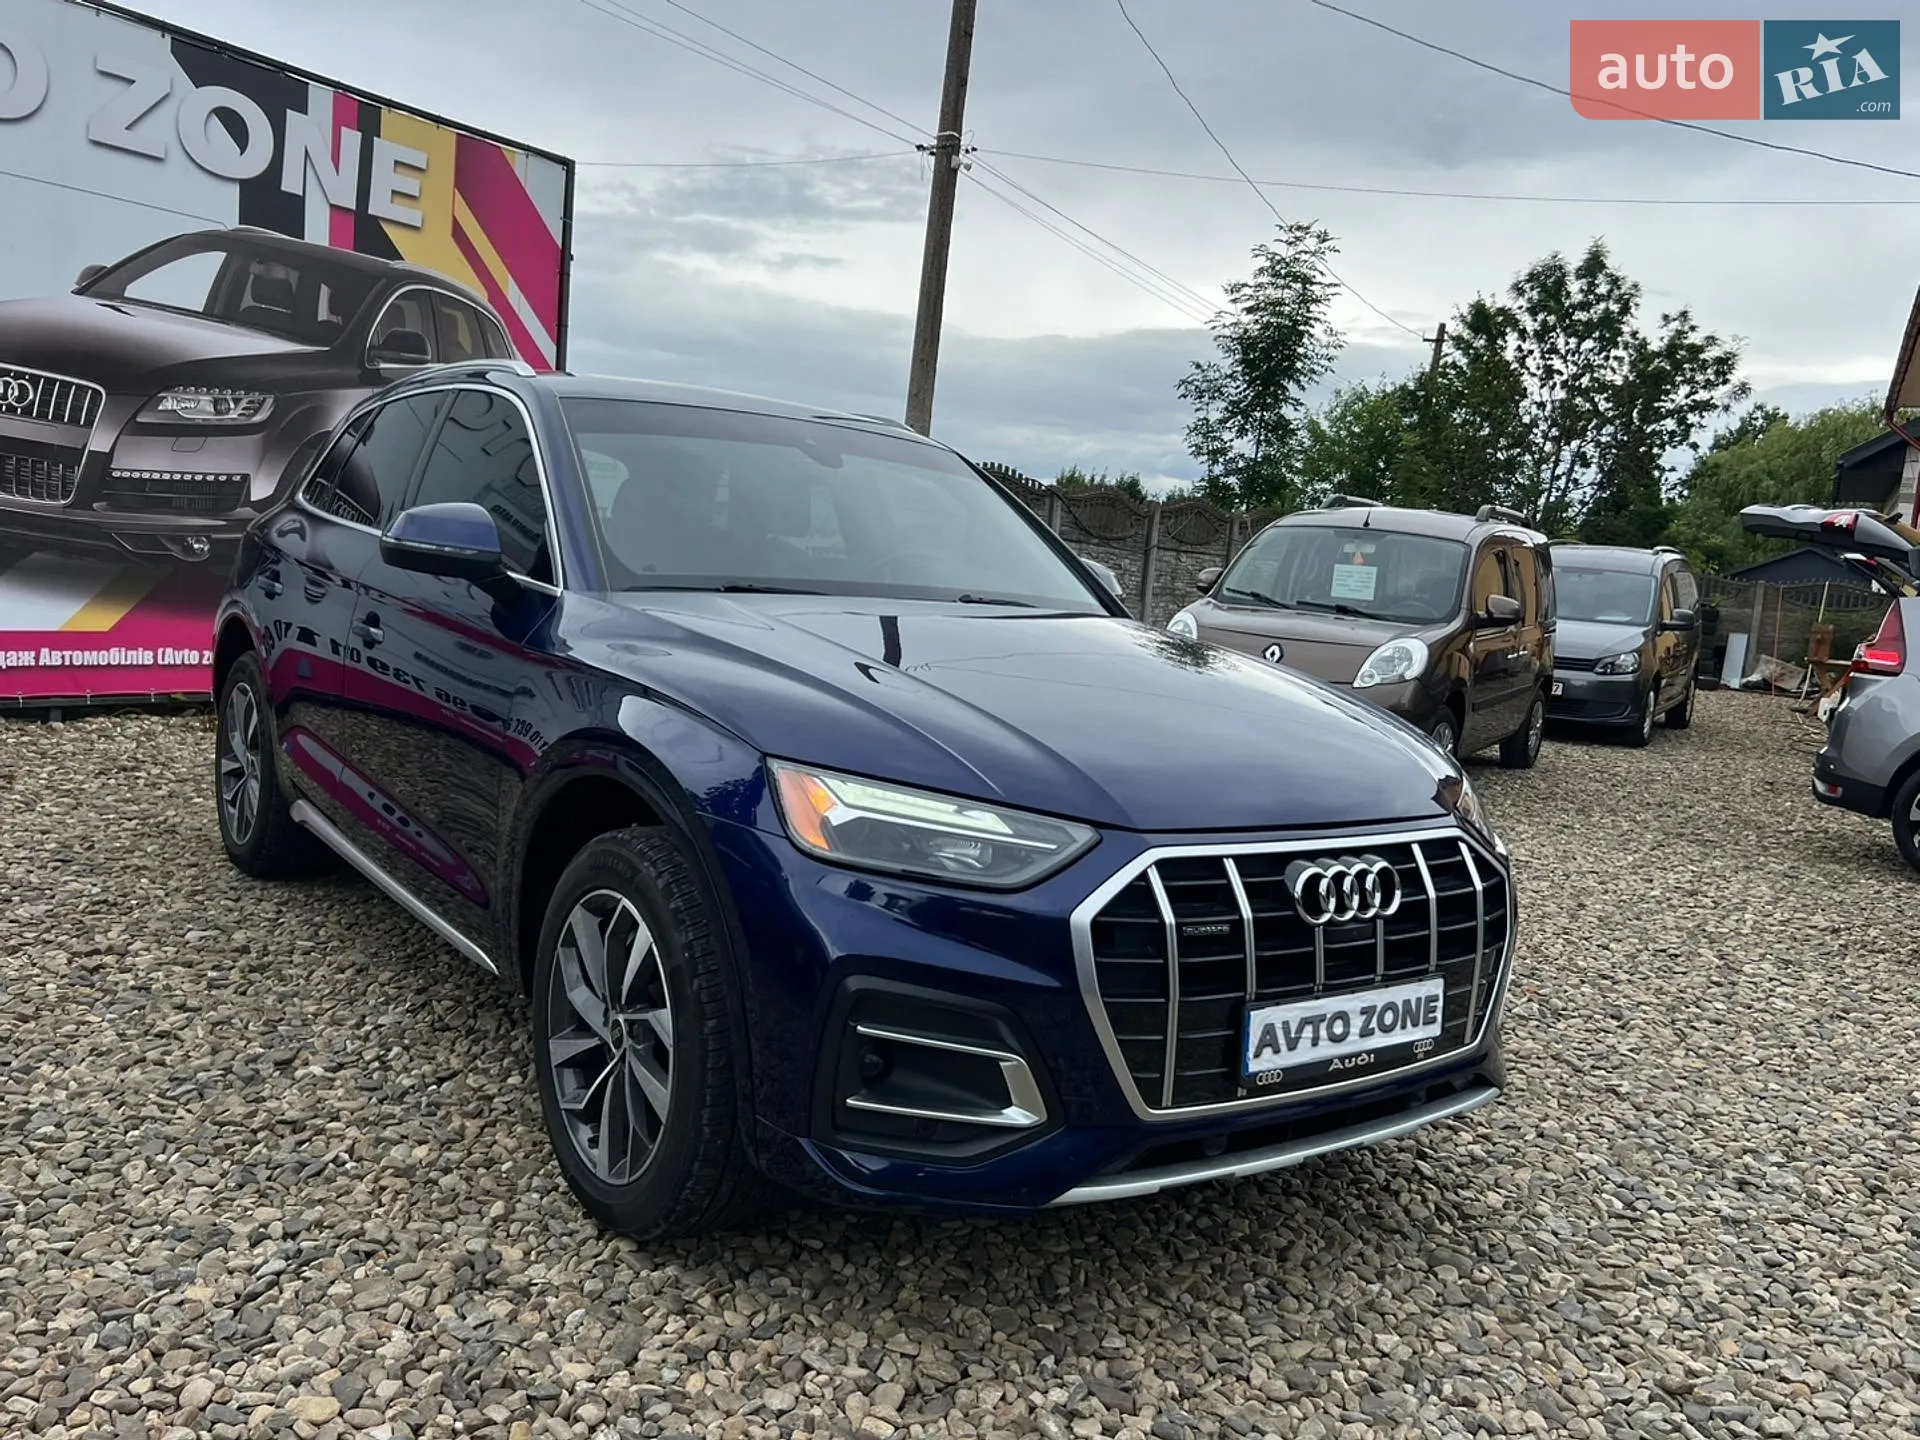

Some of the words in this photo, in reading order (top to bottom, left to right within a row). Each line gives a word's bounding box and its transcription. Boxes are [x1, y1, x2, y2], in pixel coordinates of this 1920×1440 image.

[86, 50, 429, 230] ZONE
[38, 647, 154, 667] Автомобілів
[1253, 1010, 1351, 1060] AVTO
[1358, 993, 1440, 1039] ZONE
[1328, 1053, 1375, 1072] Audi
